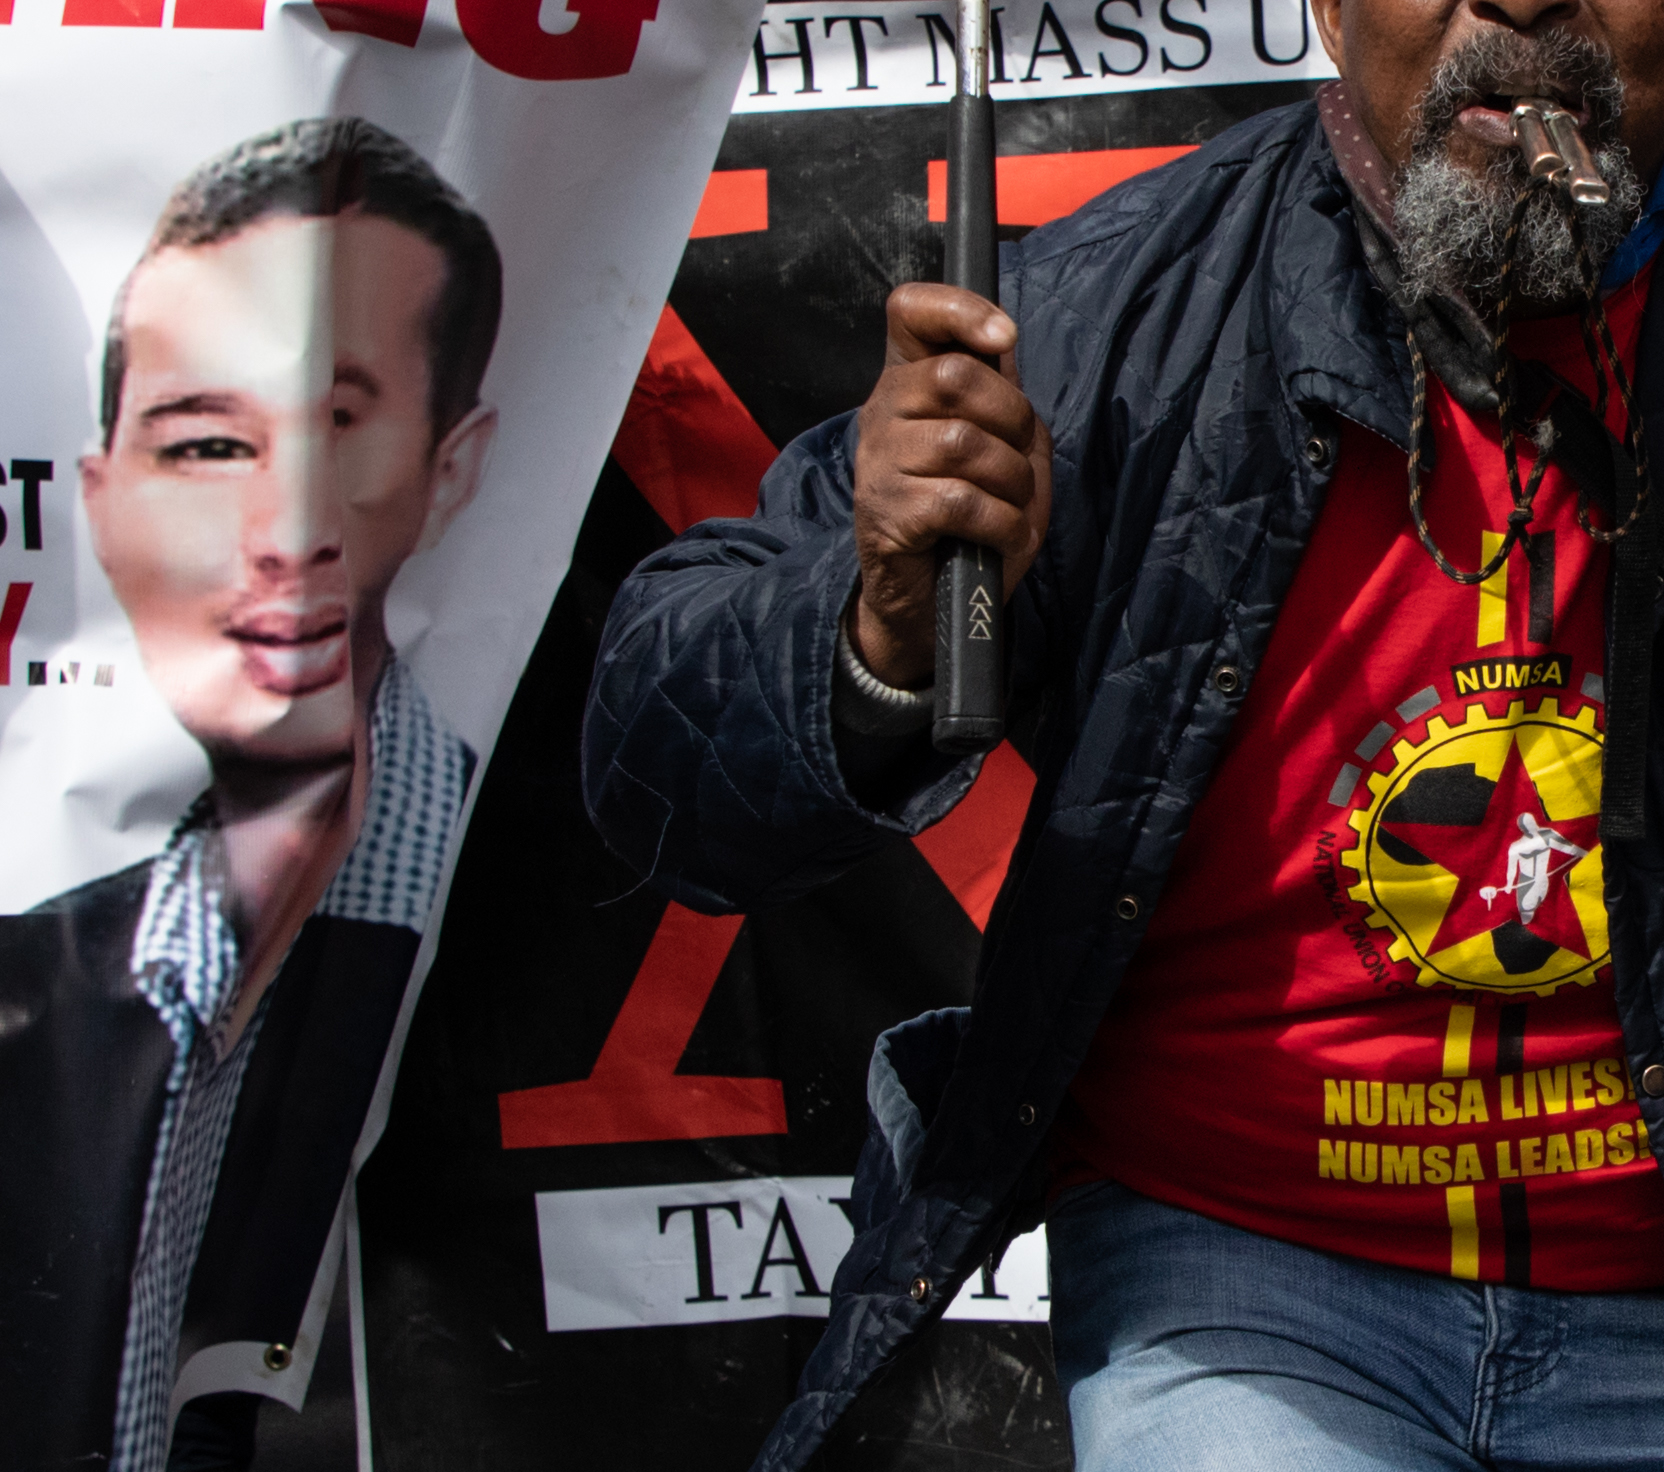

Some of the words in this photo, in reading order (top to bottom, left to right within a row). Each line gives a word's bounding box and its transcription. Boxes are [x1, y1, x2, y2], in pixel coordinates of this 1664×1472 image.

[1456, 659, 1565, 691] NUMSA
[1323, 1078, 1486, 1127] NUMSA
[1319, 1139, 1483, 1185] NUMSA
